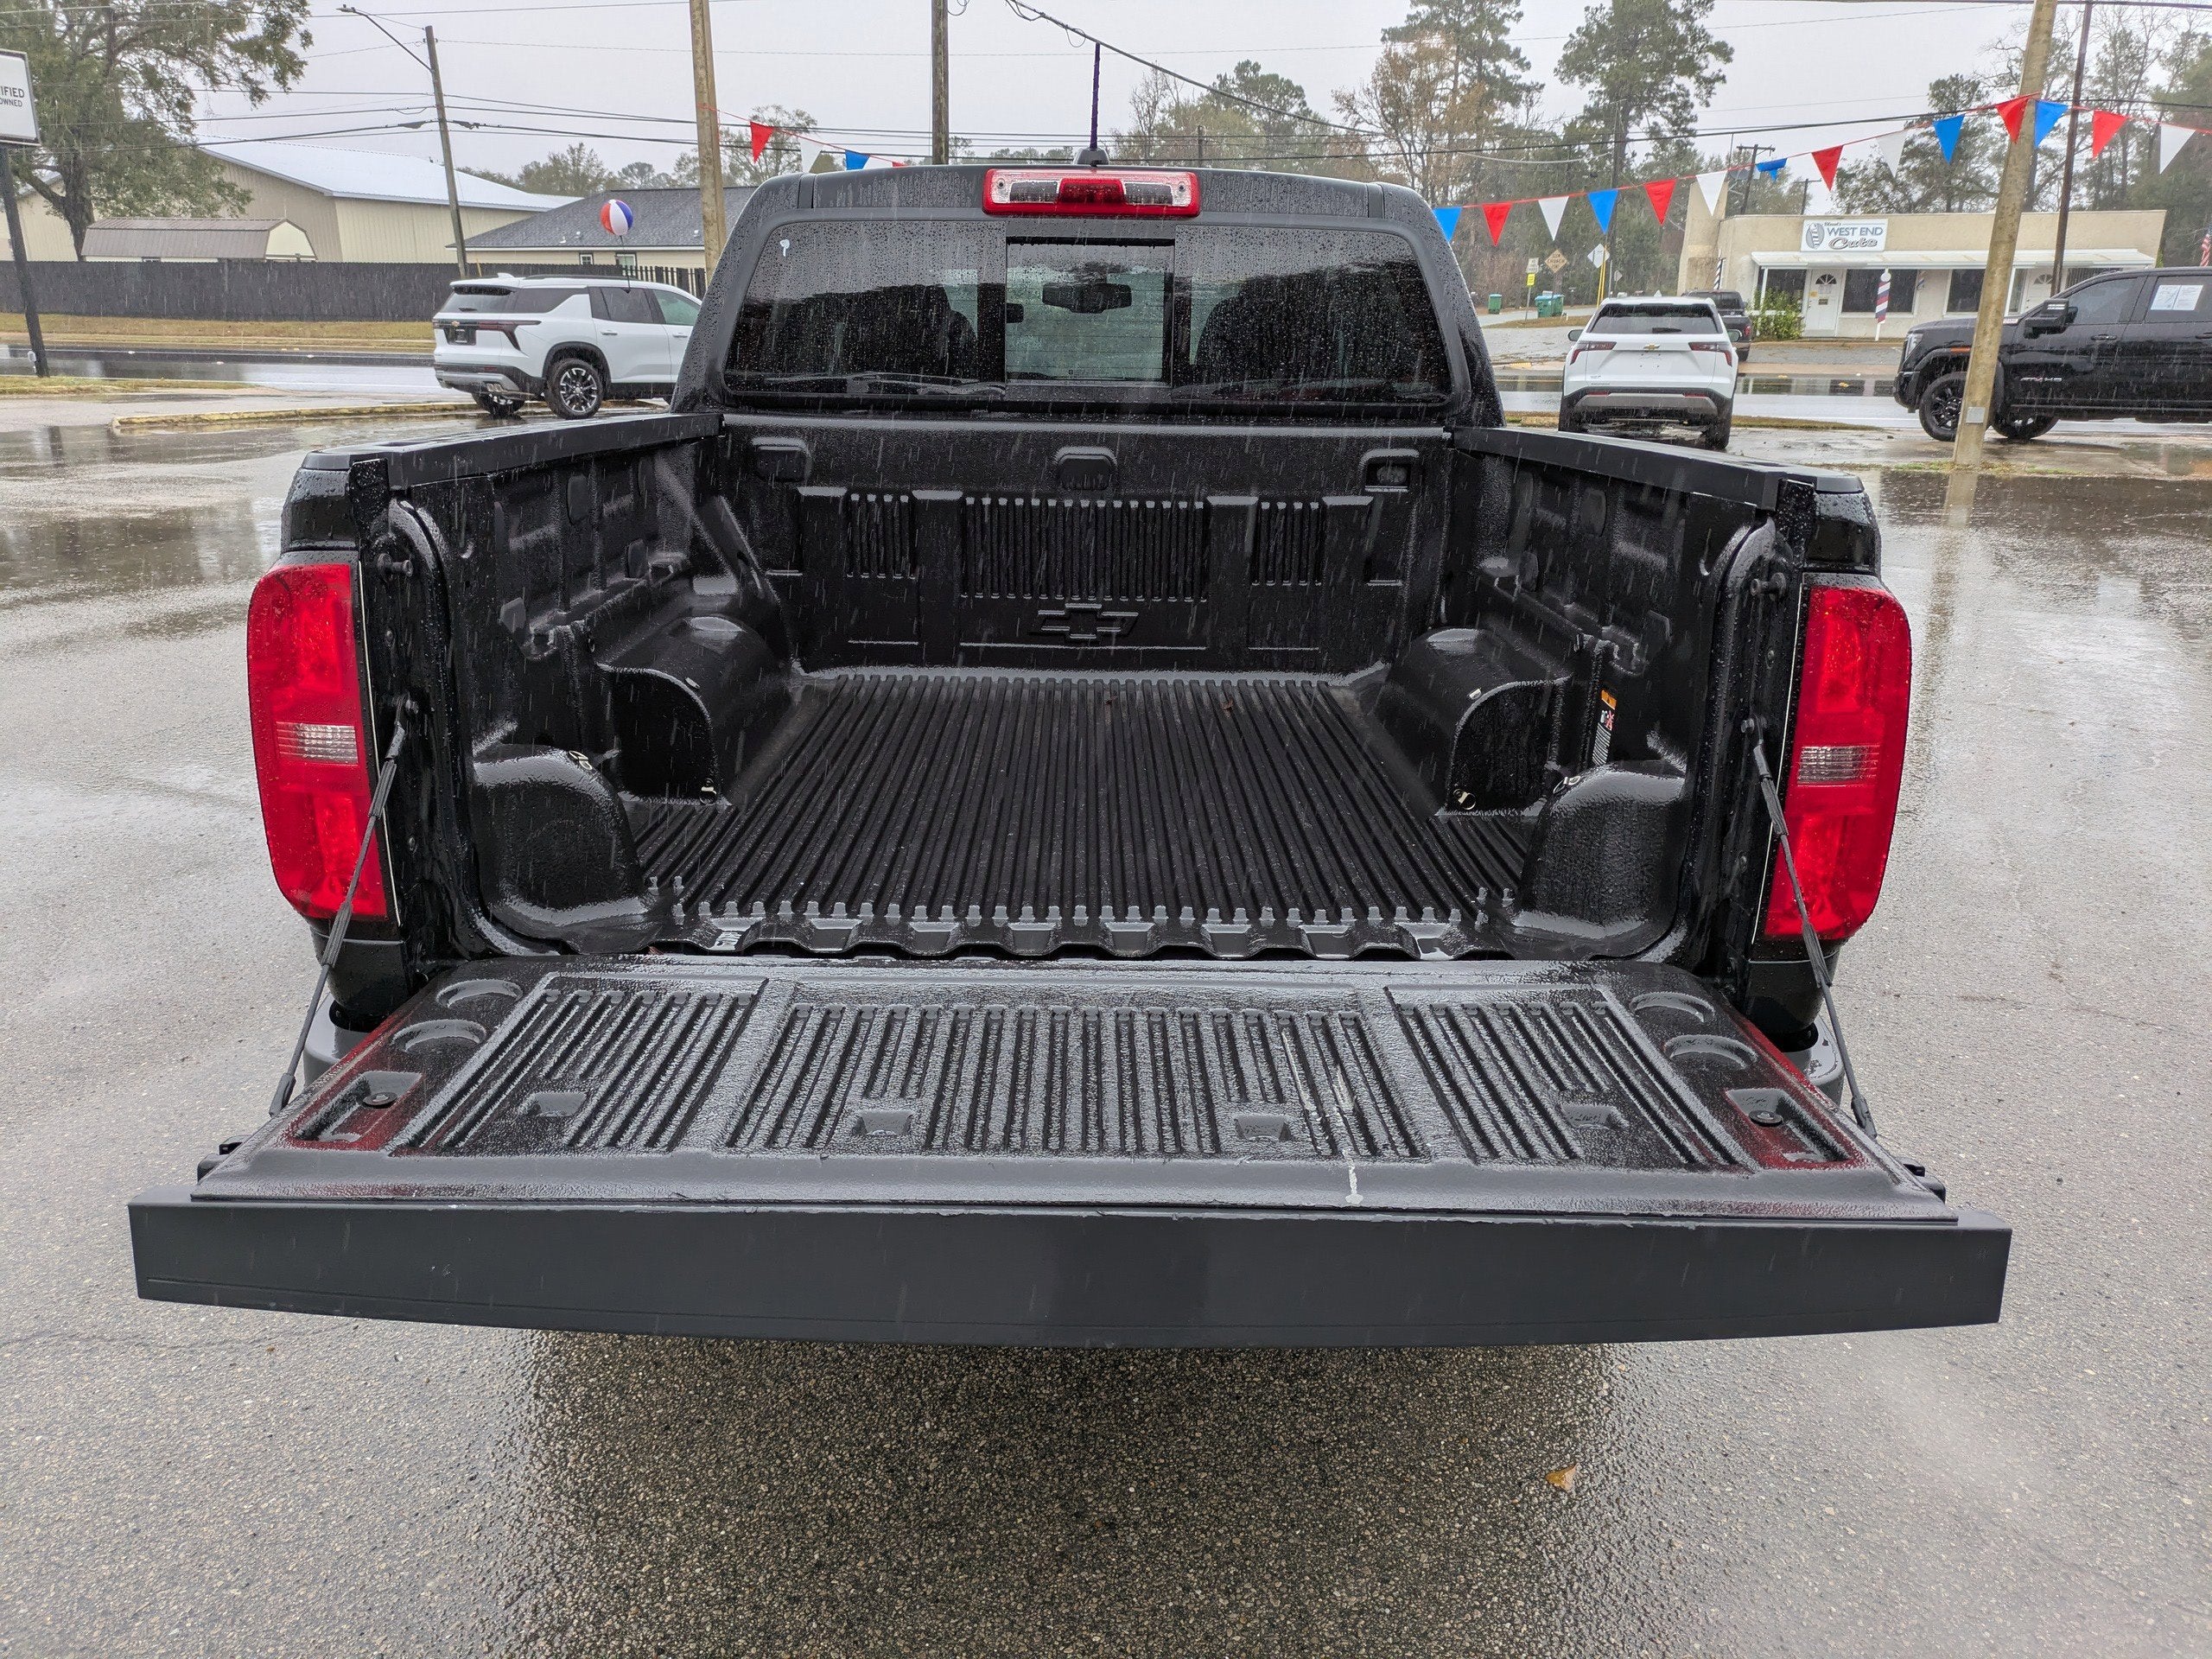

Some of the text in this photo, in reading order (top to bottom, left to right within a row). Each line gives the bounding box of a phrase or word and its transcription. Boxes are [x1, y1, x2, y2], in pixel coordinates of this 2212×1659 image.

[0, 86, 25, 98] IFIED
[1827, 226, 1884, 236] WEST END
[1827, 236, 1878, 250] Cuts
